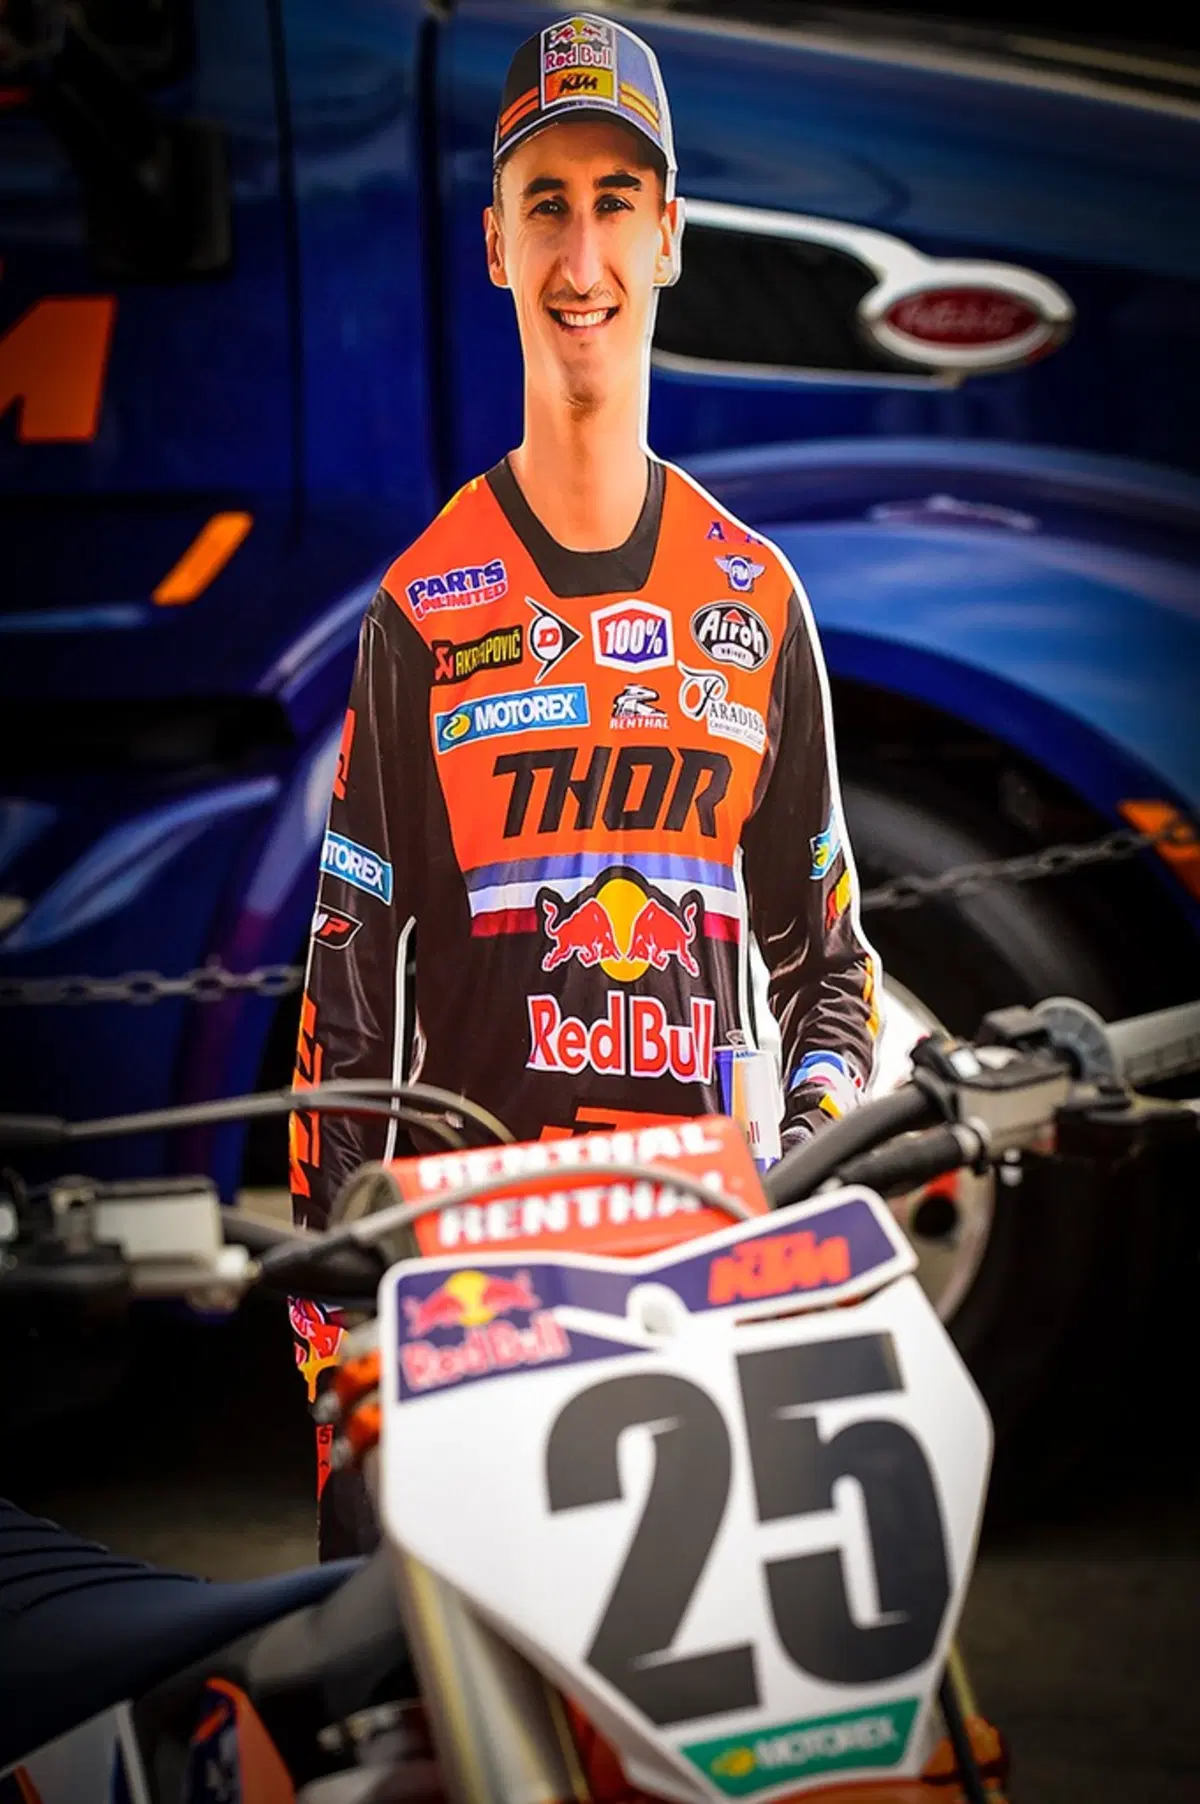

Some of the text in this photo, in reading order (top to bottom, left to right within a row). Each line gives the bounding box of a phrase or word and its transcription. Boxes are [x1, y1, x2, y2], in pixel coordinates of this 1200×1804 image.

[545, 44, 612, 72] Red Bull
[559, 73, 599, 93] KTM
[406, 560, 505, 606] PARTS
[414, 581, 507, 620] UNLIMITED
[605, 618, 663, 656] 100%
[699, 609, 766, 658] Airoh
[474, 692, 578, 732] MOTOREX
[610, 717, 670, 730] RENTHAL
[493, 746, 733, 839] THOR
[525, 990, 716, 1085] Red Bull
[418, 1123, 722, 1190] RENTHAL
[708, 1231, 852, 1305] KTM
[401, 1310, 572, 1392] Red Bull
[546, 1331, 955, 1730] 25
